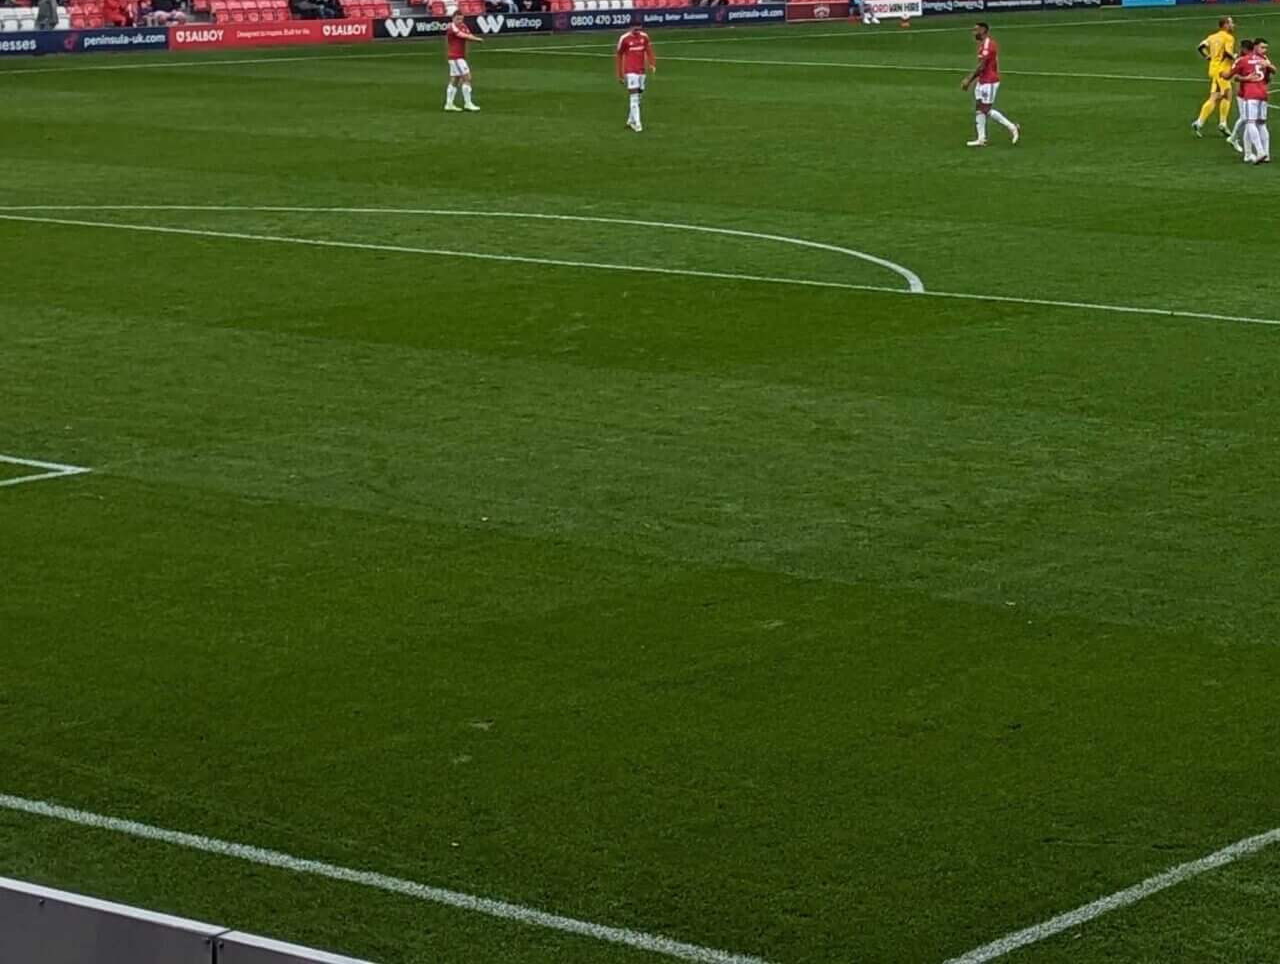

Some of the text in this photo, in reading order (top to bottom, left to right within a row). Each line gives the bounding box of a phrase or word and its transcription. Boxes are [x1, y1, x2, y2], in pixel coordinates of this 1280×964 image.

[889, 3, 903, 13] VAN
[904, 2, 920, 12] HIRE
[570, 13, 631, 27] 0800 470 3239
[728, 9, 784, 21] peninsula-uk.com
[416, 22, 450, 32] WeSho
[506, 18, 542, 29] WeShop
[185, 29, 224, 43] SALBOY
[332, 24, 367, 36] SALBOY
[84, 34, 166, 48] peninsula-uk.com
